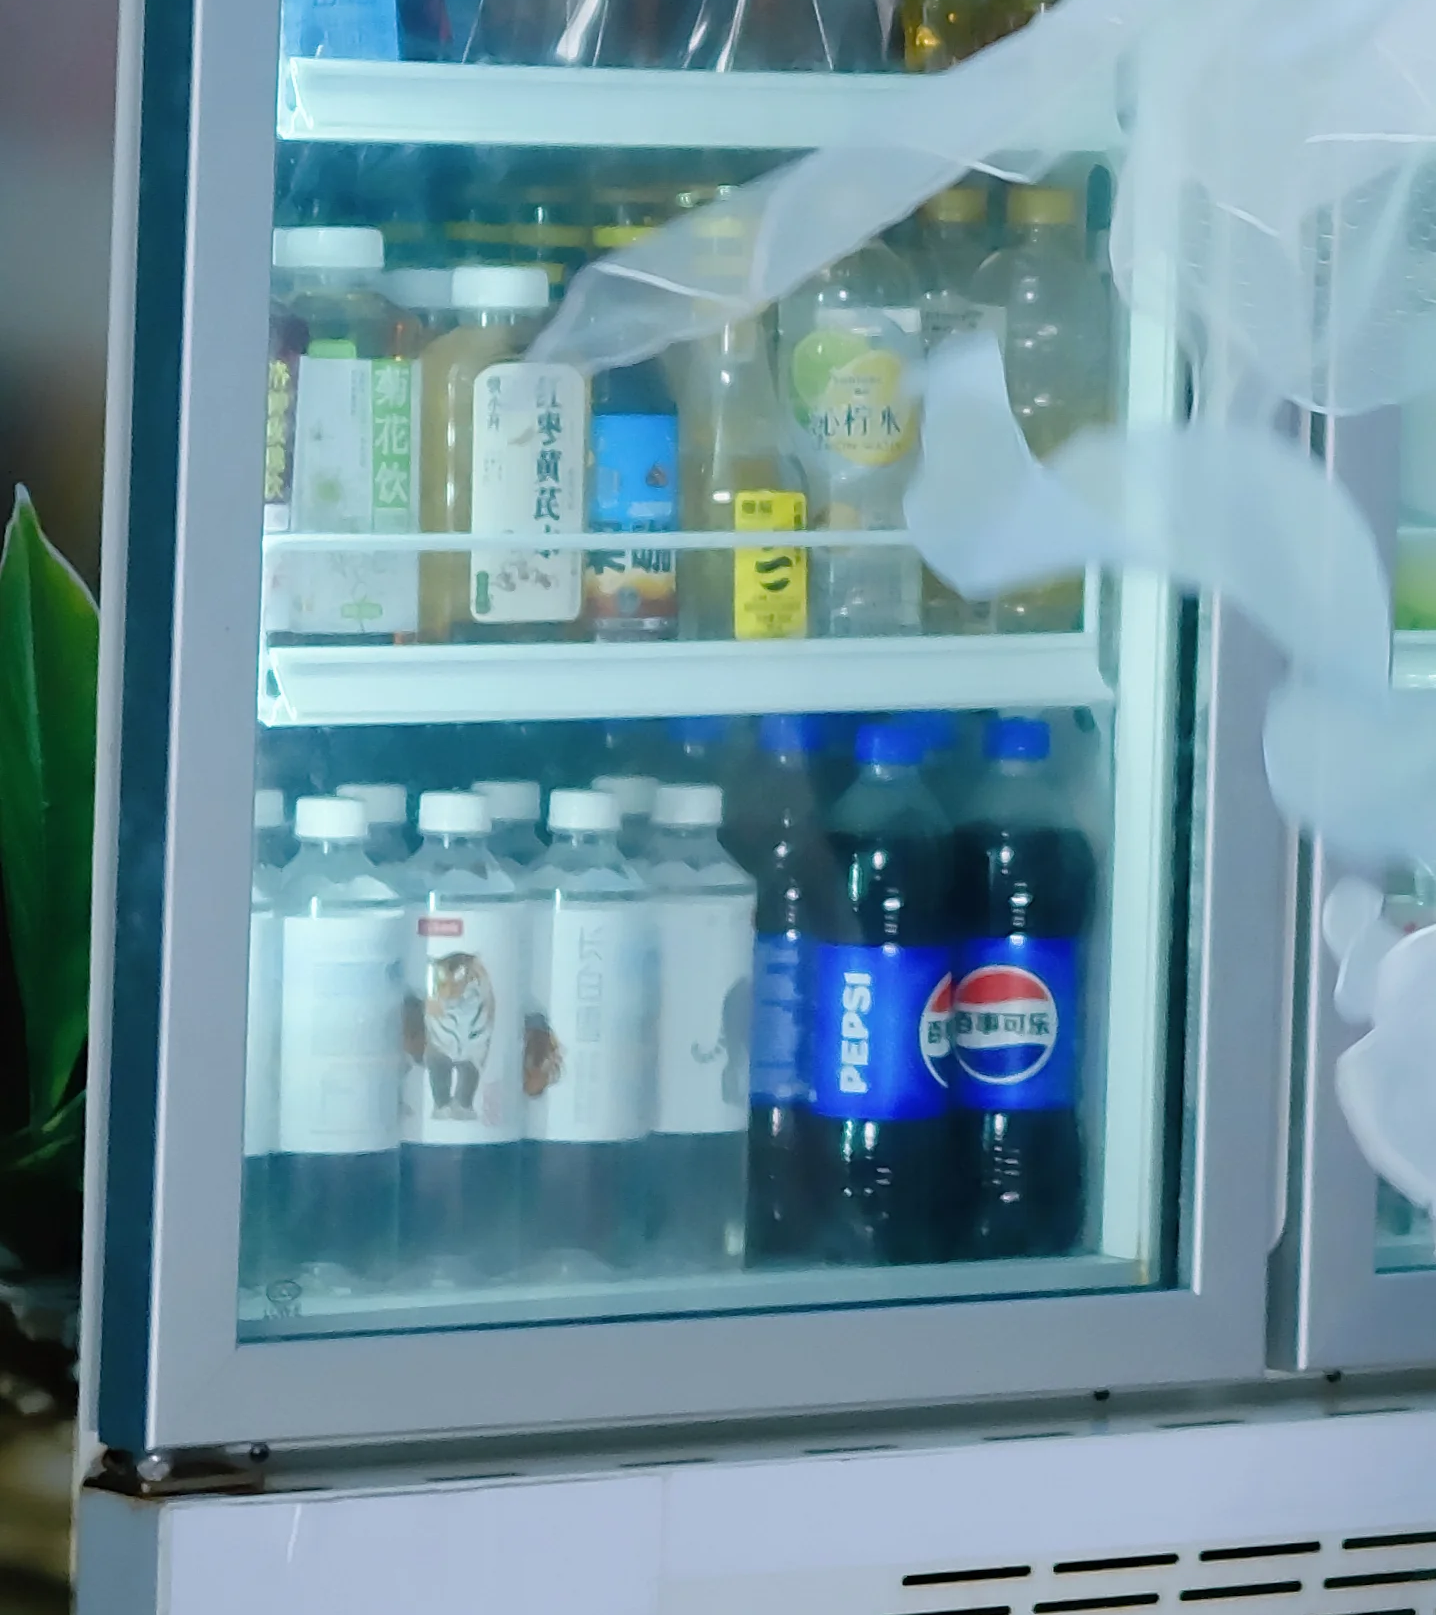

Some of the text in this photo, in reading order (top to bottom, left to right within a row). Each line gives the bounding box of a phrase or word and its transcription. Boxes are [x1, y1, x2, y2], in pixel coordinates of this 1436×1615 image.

[375, 364, 410, 505] 菊花饮
[840, 972, 871, 1092] PEPSI
